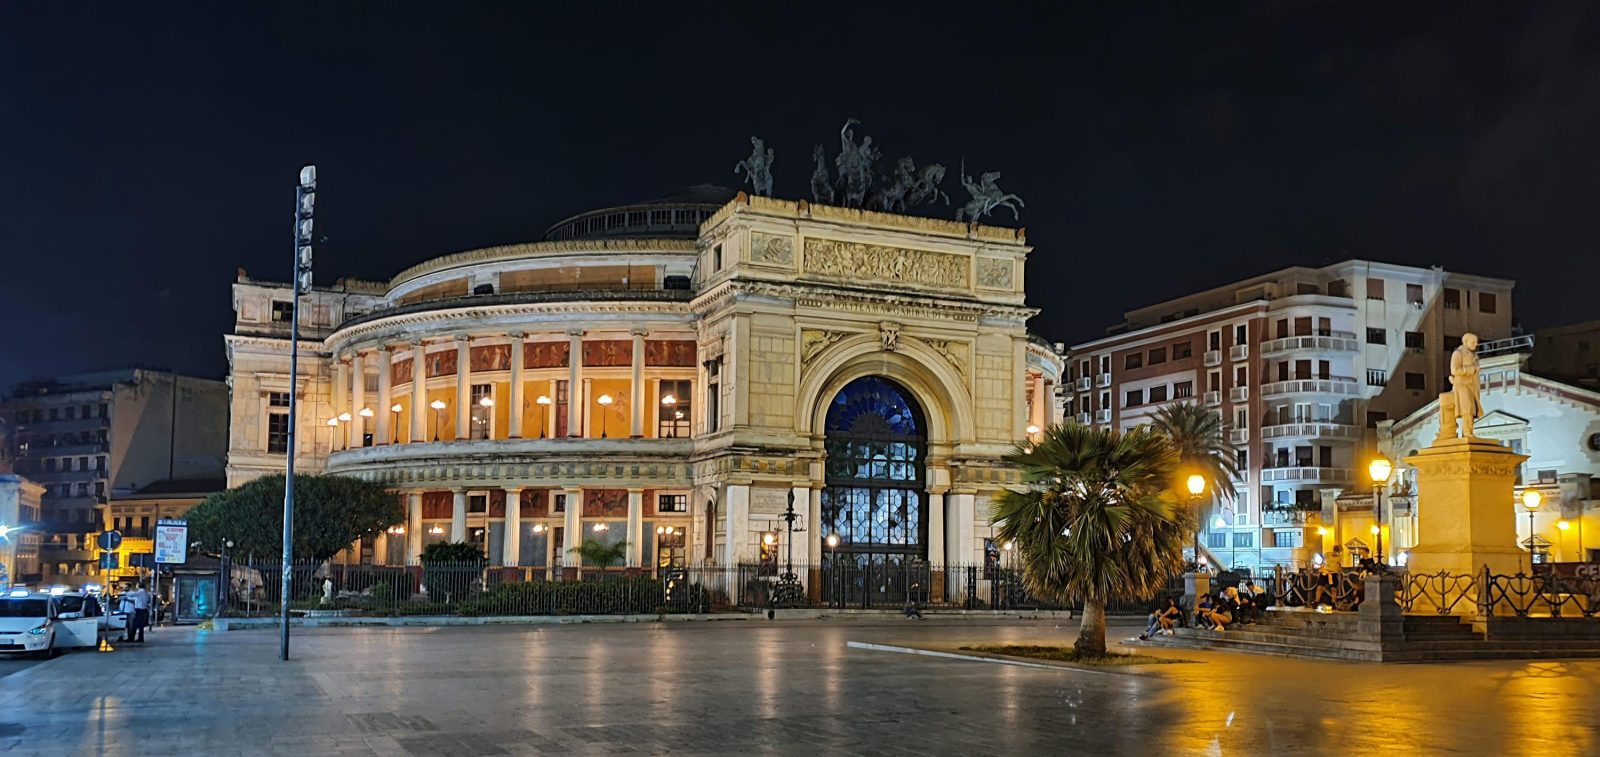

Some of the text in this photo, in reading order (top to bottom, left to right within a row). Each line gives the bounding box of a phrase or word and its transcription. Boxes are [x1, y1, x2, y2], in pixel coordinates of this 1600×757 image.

[833, 301, 941, 319] POLITEAMA GARIBALDI
[1574, 564, 1600, 577] GE
